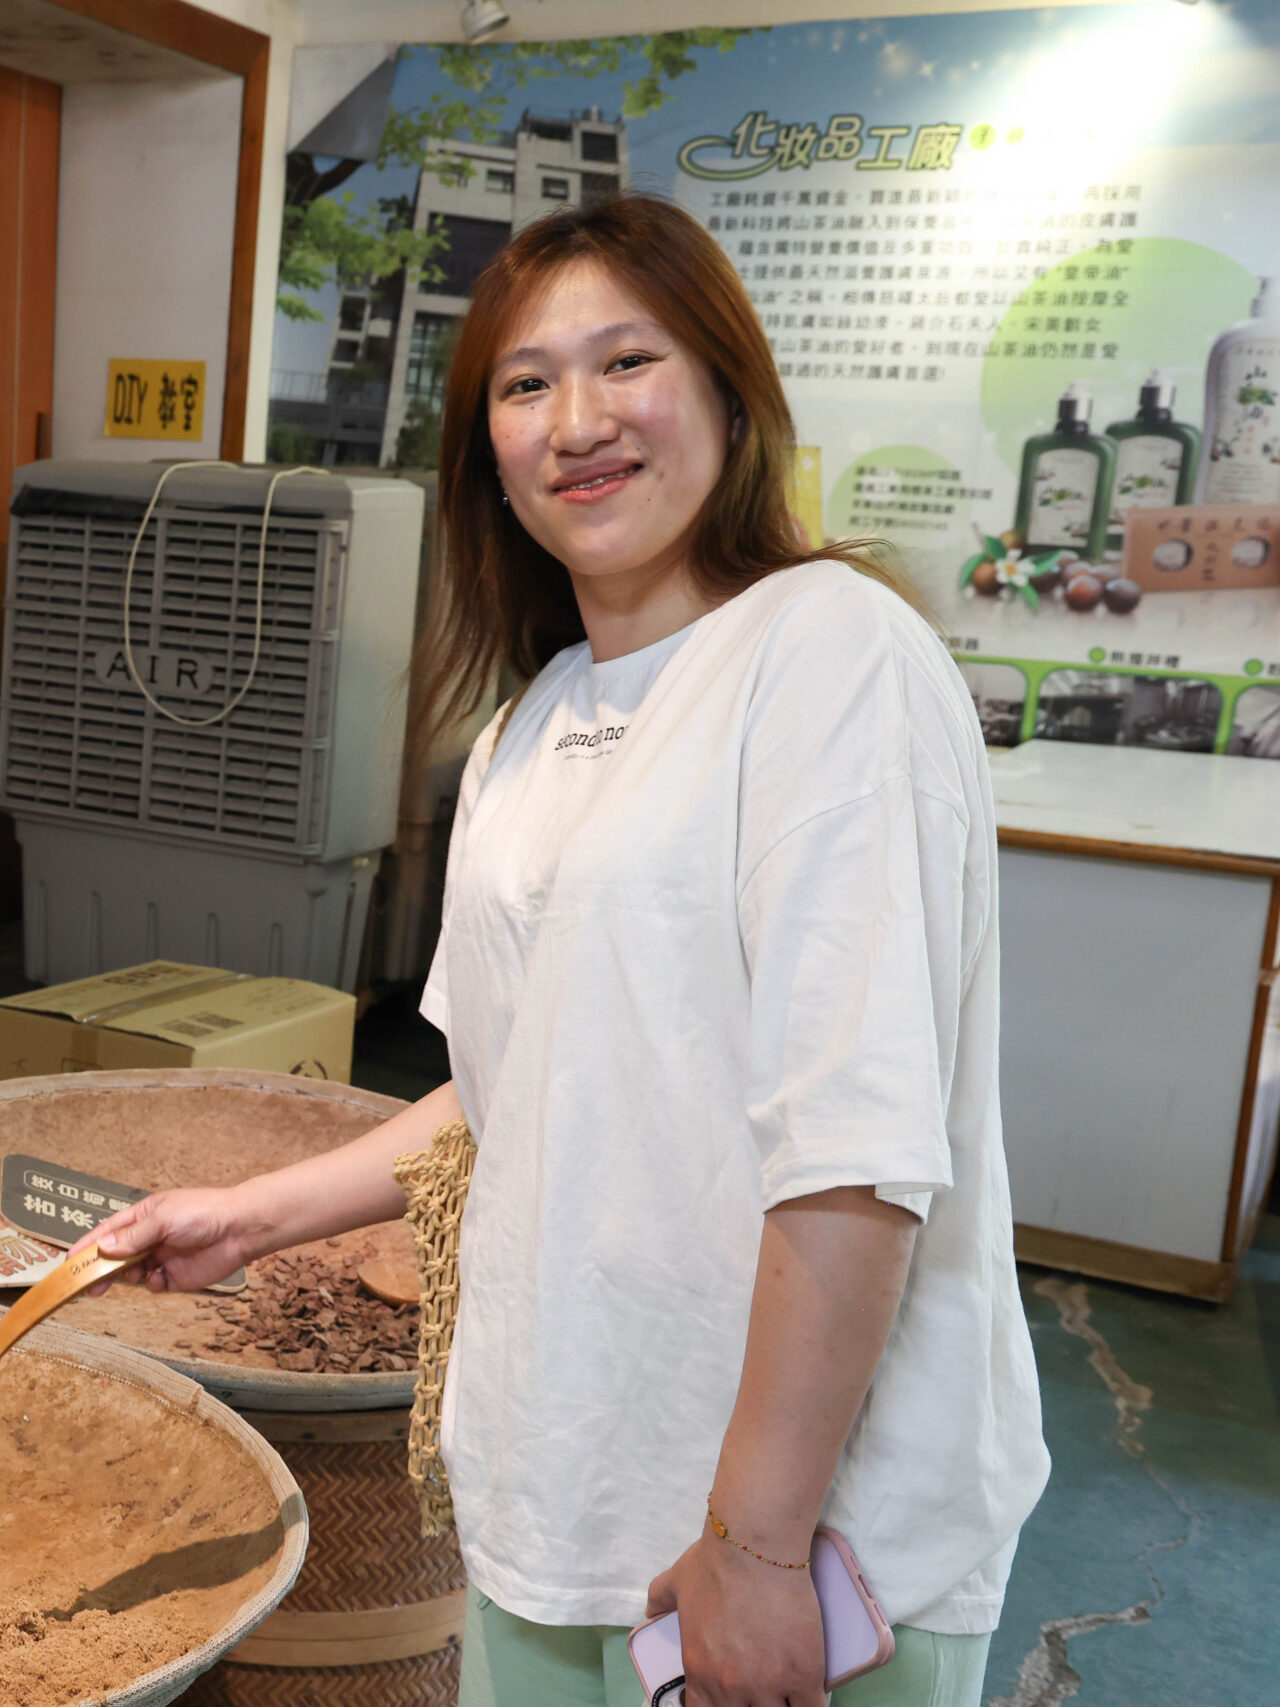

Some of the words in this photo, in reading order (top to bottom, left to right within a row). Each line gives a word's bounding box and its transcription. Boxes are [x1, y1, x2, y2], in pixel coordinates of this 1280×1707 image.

[113, 373, 148, 425] DIY
[106, 651, 199, 689] AIR
[24, 1193, 107, 1230] 苦茶
